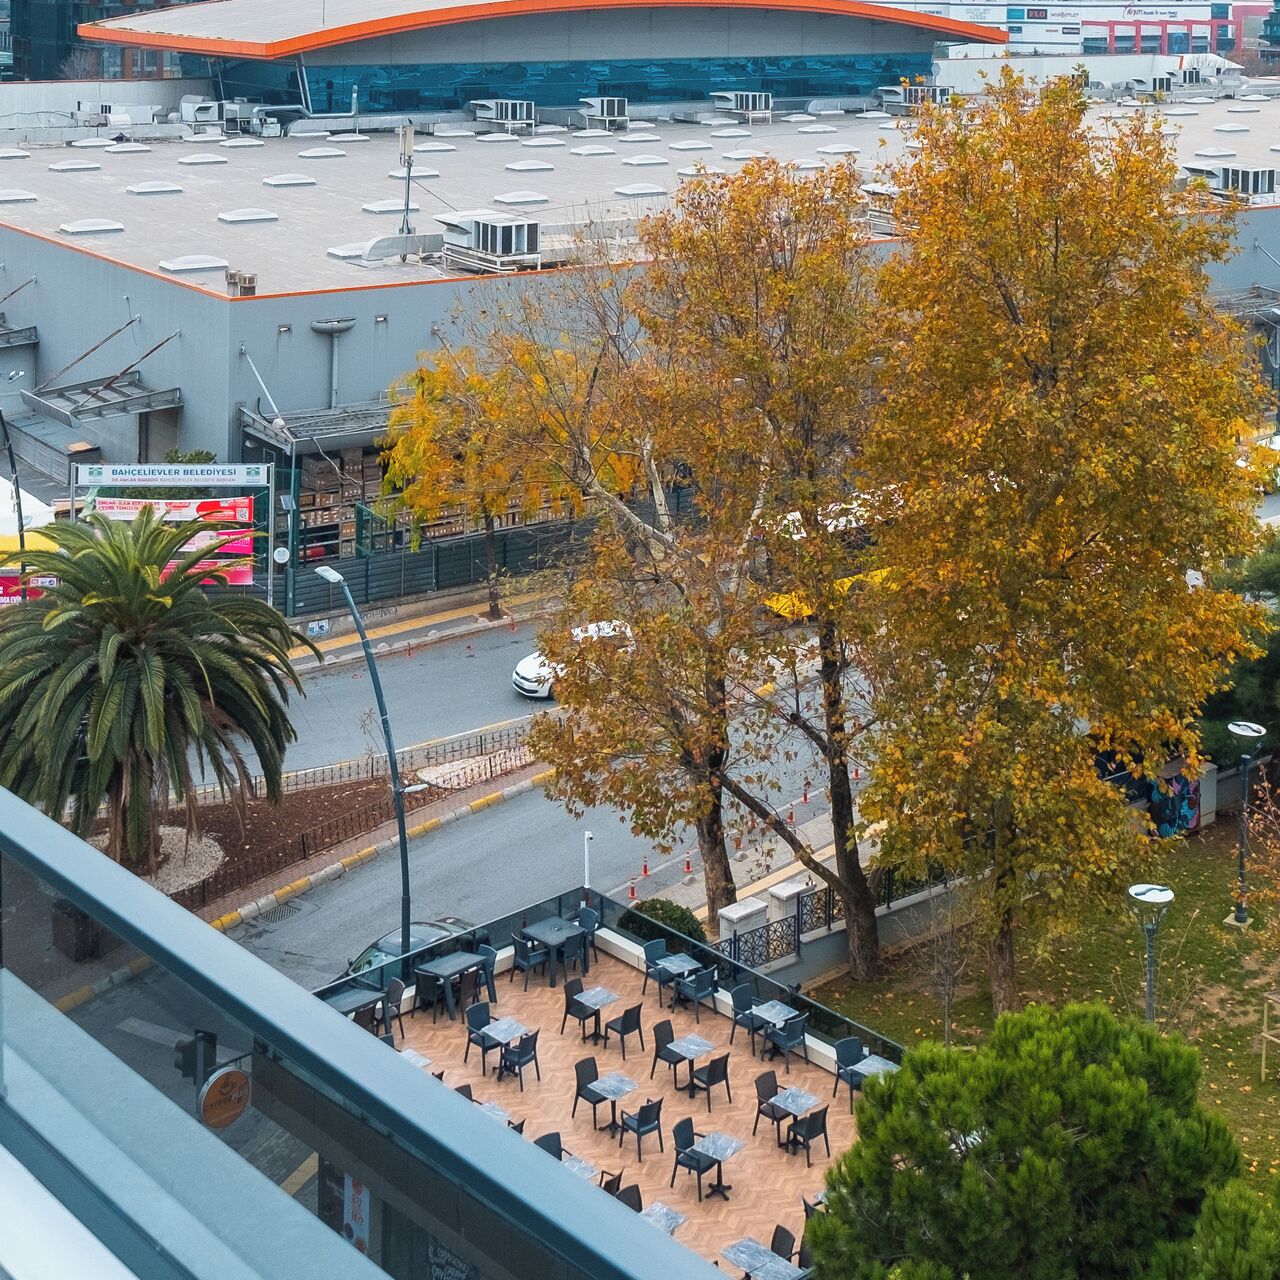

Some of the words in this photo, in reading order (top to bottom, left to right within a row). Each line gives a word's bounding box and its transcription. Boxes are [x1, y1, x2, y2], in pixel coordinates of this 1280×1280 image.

[1028, 10, 1046, 18] FLO
[112, 468, 180, 476] BAHÇELİEVLER
[183, 468, 236, 476] BELEDİYESİ
